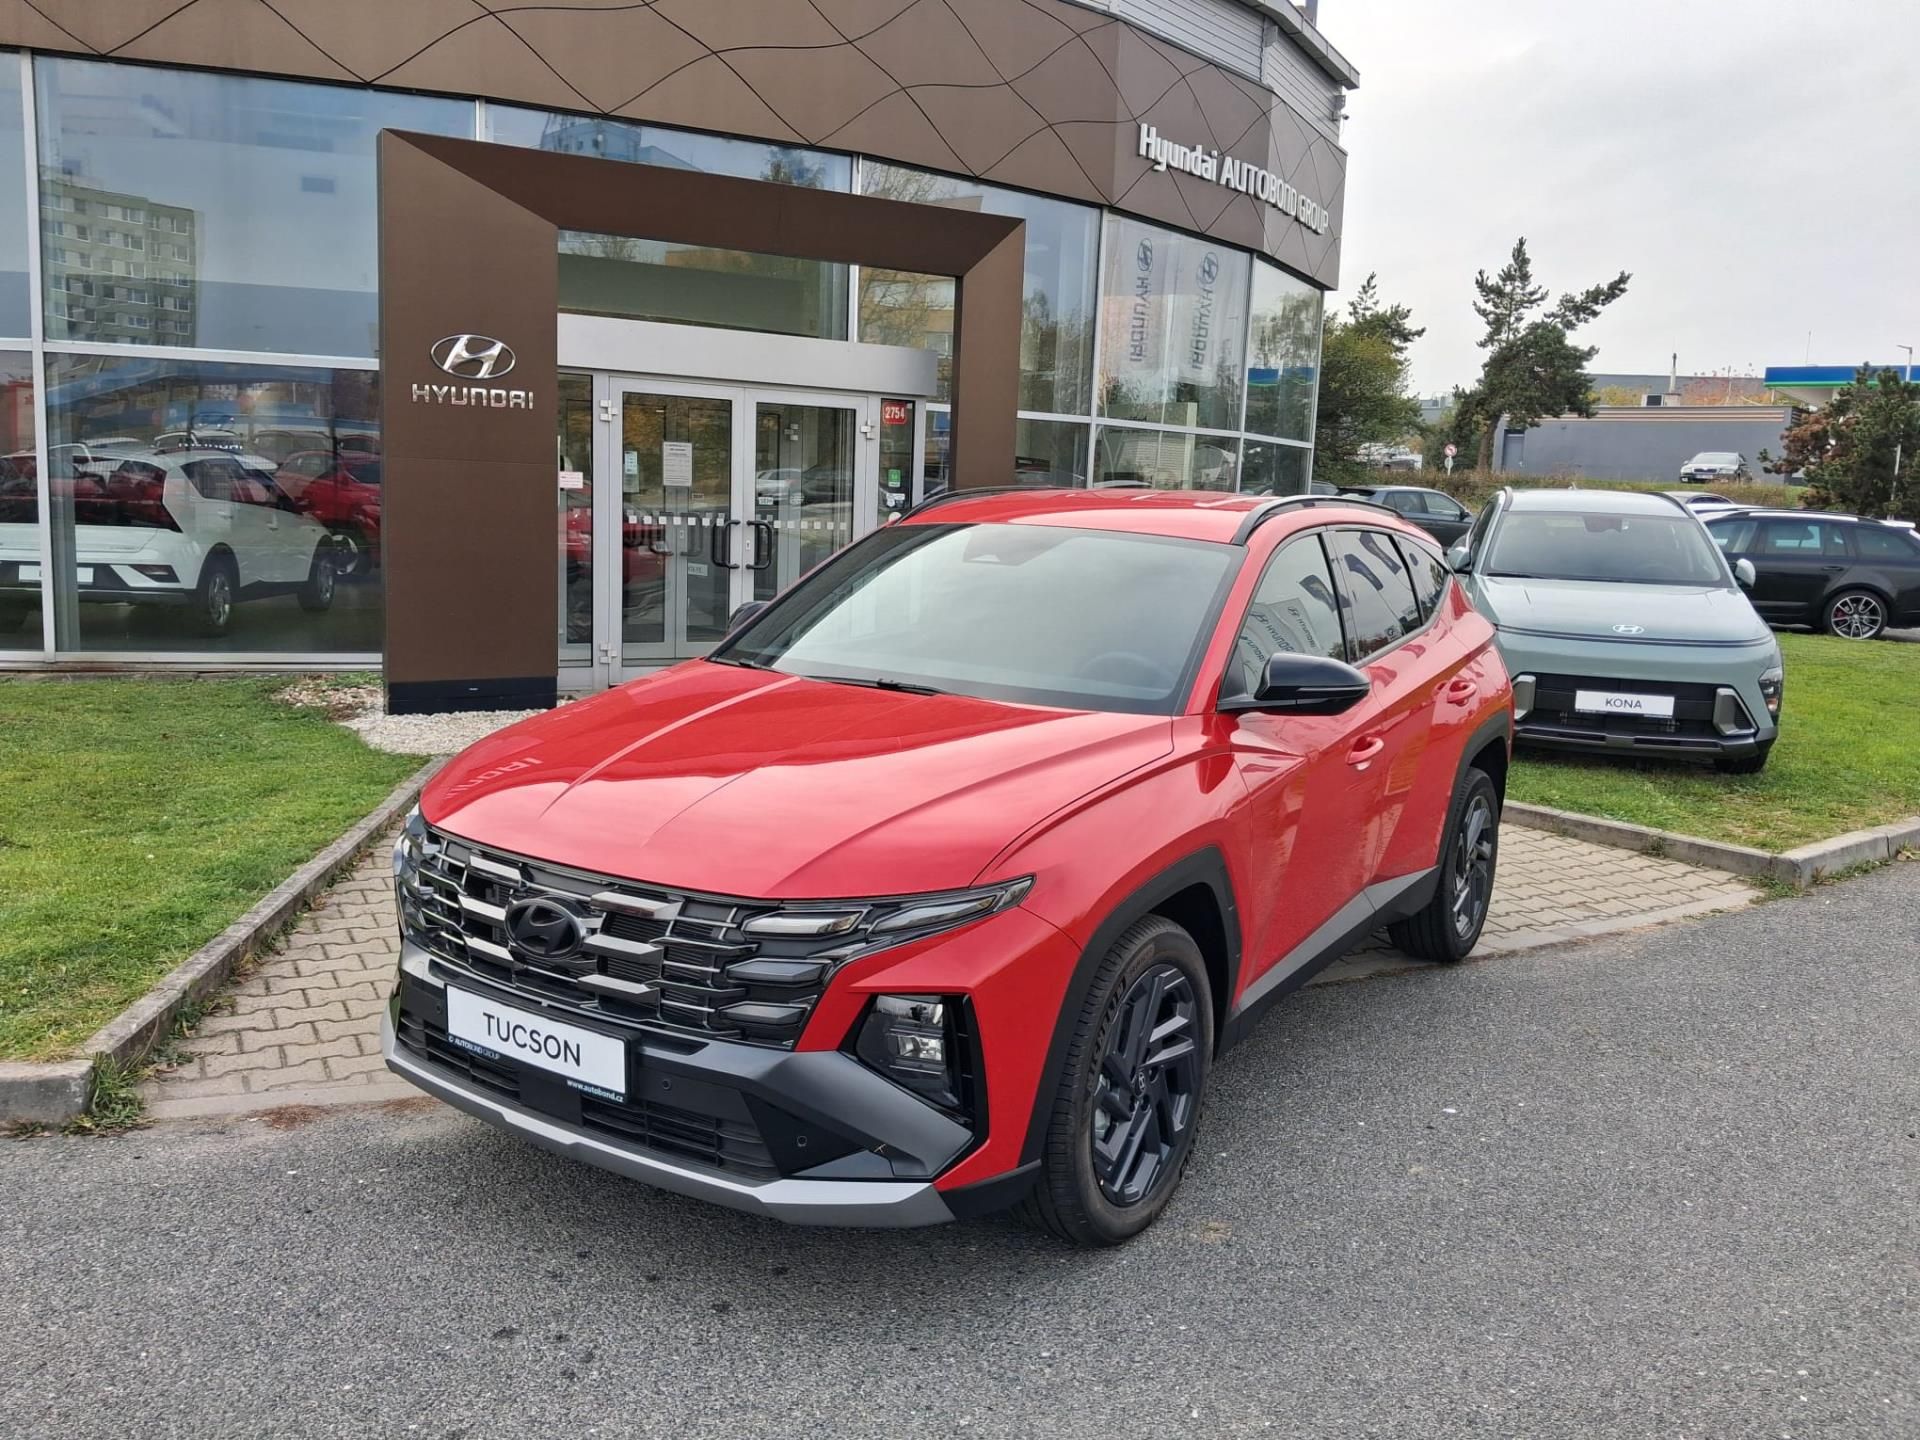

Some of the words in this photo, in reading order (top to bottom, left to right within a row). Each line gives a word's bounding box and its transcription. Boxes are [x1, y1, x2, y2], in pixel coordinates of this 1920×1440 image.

[1139, 123, 1218, 182] Hyundai
[1298, 194, 1329, 236] GROUP
[1129, 276, 1151, 362] HYUNDAI
[1191, 287, 1214, 370] HYUNDAI
[411, 383, 534, 410] HYUNDAI
[884, 406, 905, 420] 2754
[1605, 697, 1642, 709] KONA
[482, 1011, 581, 1068] TUCSON
[566, 1079, 624, 1103] www.autobond.cz
